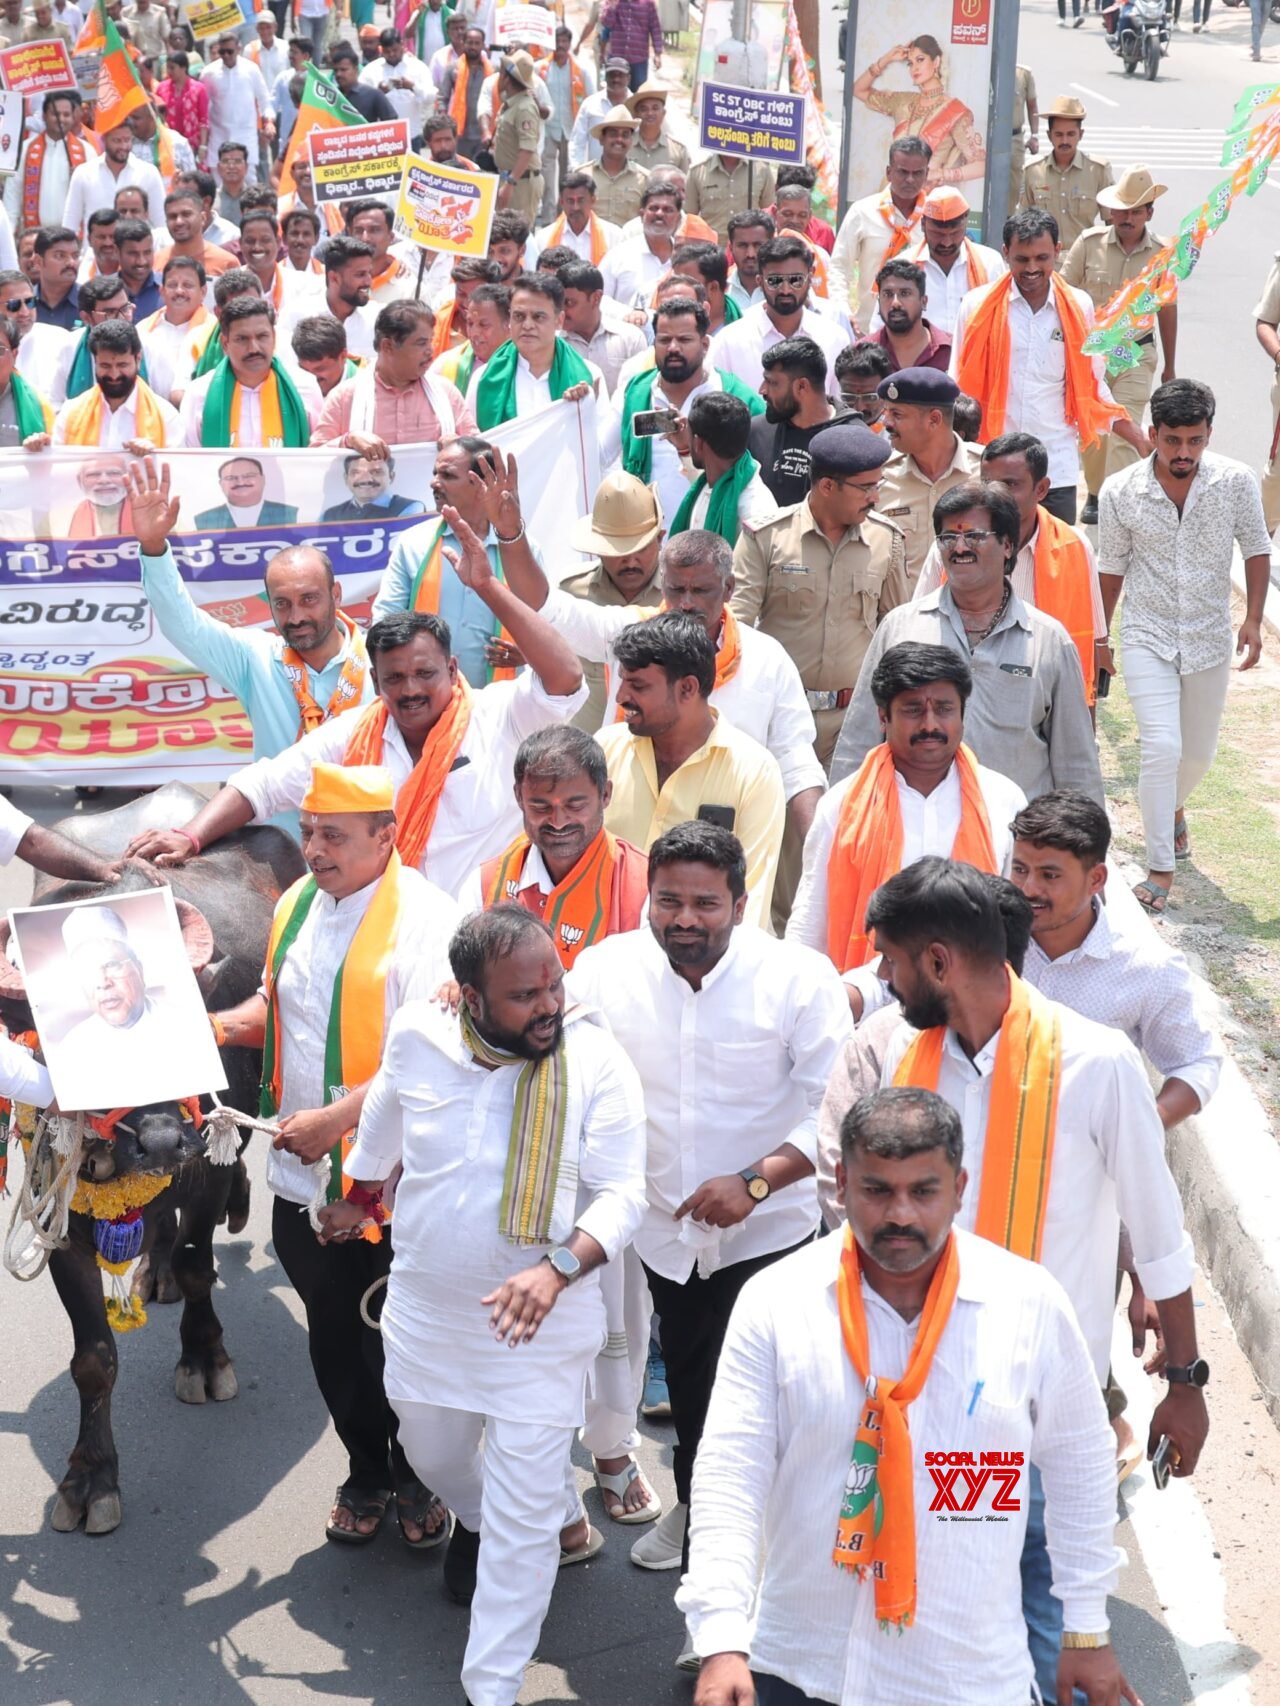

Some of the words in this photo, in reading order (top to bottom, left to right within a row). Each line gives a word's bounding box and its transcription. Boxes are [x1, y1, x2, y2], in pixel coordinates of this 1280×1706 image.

[712, 92, 725, 104] SC
[727, 95, 741, 106] ST
[743, 98, 765, 111] OBC
[767, 101, 794, 114] ಗಳಿಗೆ
[714, 105, 758, 123] ಕಾಂಗ್ರೆಸ್
[323, 163, 361, 178] ಕಾಂಗ್ರೆಸ್
[363, 156, 401, 171] ಸರ್ಕಾರಕ್ಕೆ
[0, 598, 150, 631] ವಿರುದ್ಧ
